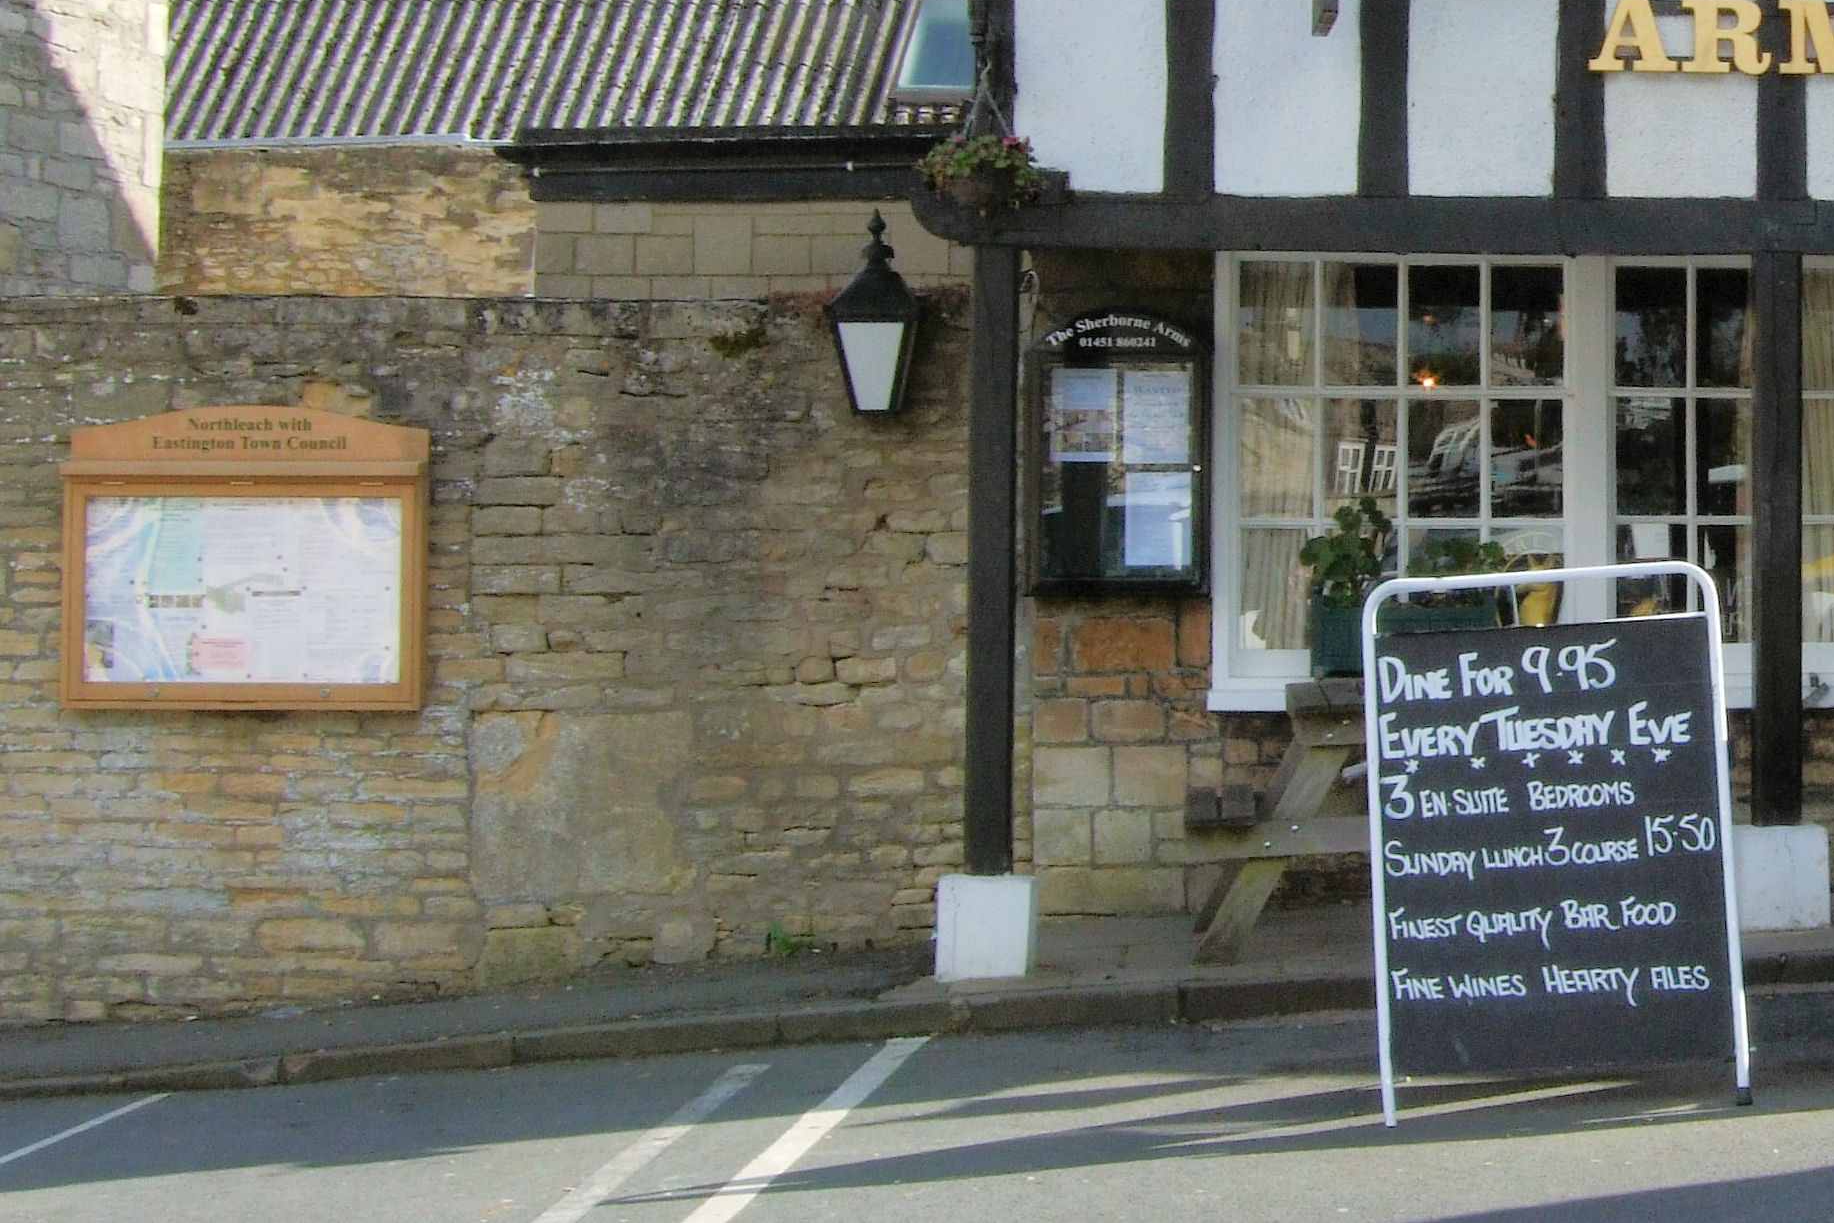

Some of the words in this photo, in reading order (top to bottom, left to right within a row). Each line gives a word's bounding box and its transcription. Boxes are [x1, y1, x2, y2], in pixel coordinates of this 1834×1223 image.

[1045, 327, 1074, 347] The
[1075, 314, 1151, 333] Sherborne
[1153, 322, 1192, 348] Arms
[153, 436, 235, 452] Eastington
[240, 436, 282, 450] Town
[287, 436, 347, 450] Council
[188, 417, 273, 431] Northleach
[278, 418, 312, 431] with
[1377, 655, 1452, 704] DINE
[1457, 651, 1514, 697] FOR
[1377, 711, 1480, 760] EVERY
[1479, 703, 1615, 752] TUESDAY
[1628, 700, 1693, 748] EVE
[1379, 775, 1415, 820] 3
[1527, 780, 1636, 813] BEDROOMS
[1383, 839, 1475, 881] SUNDAY
[1482, 842, 1543, 870] LUNCH
[1544, 825, 1574, 867] 3
[1574, 837, 1639, 865] COURSE
[1388, 907, 1462, 941] FINEST
[1465, 907, 1553, 950] QUALITY
[1560, 898, 1621, 930] BAR
[1620, 894, 1678, 927] FOOD
[1391, 968, 1444, 1003] FINE
[1448, 971, 1528, 1000] WINES
[1541, 963, 1641, 1008] HEARTY
[1650, 965, 1711, 993] ALES
